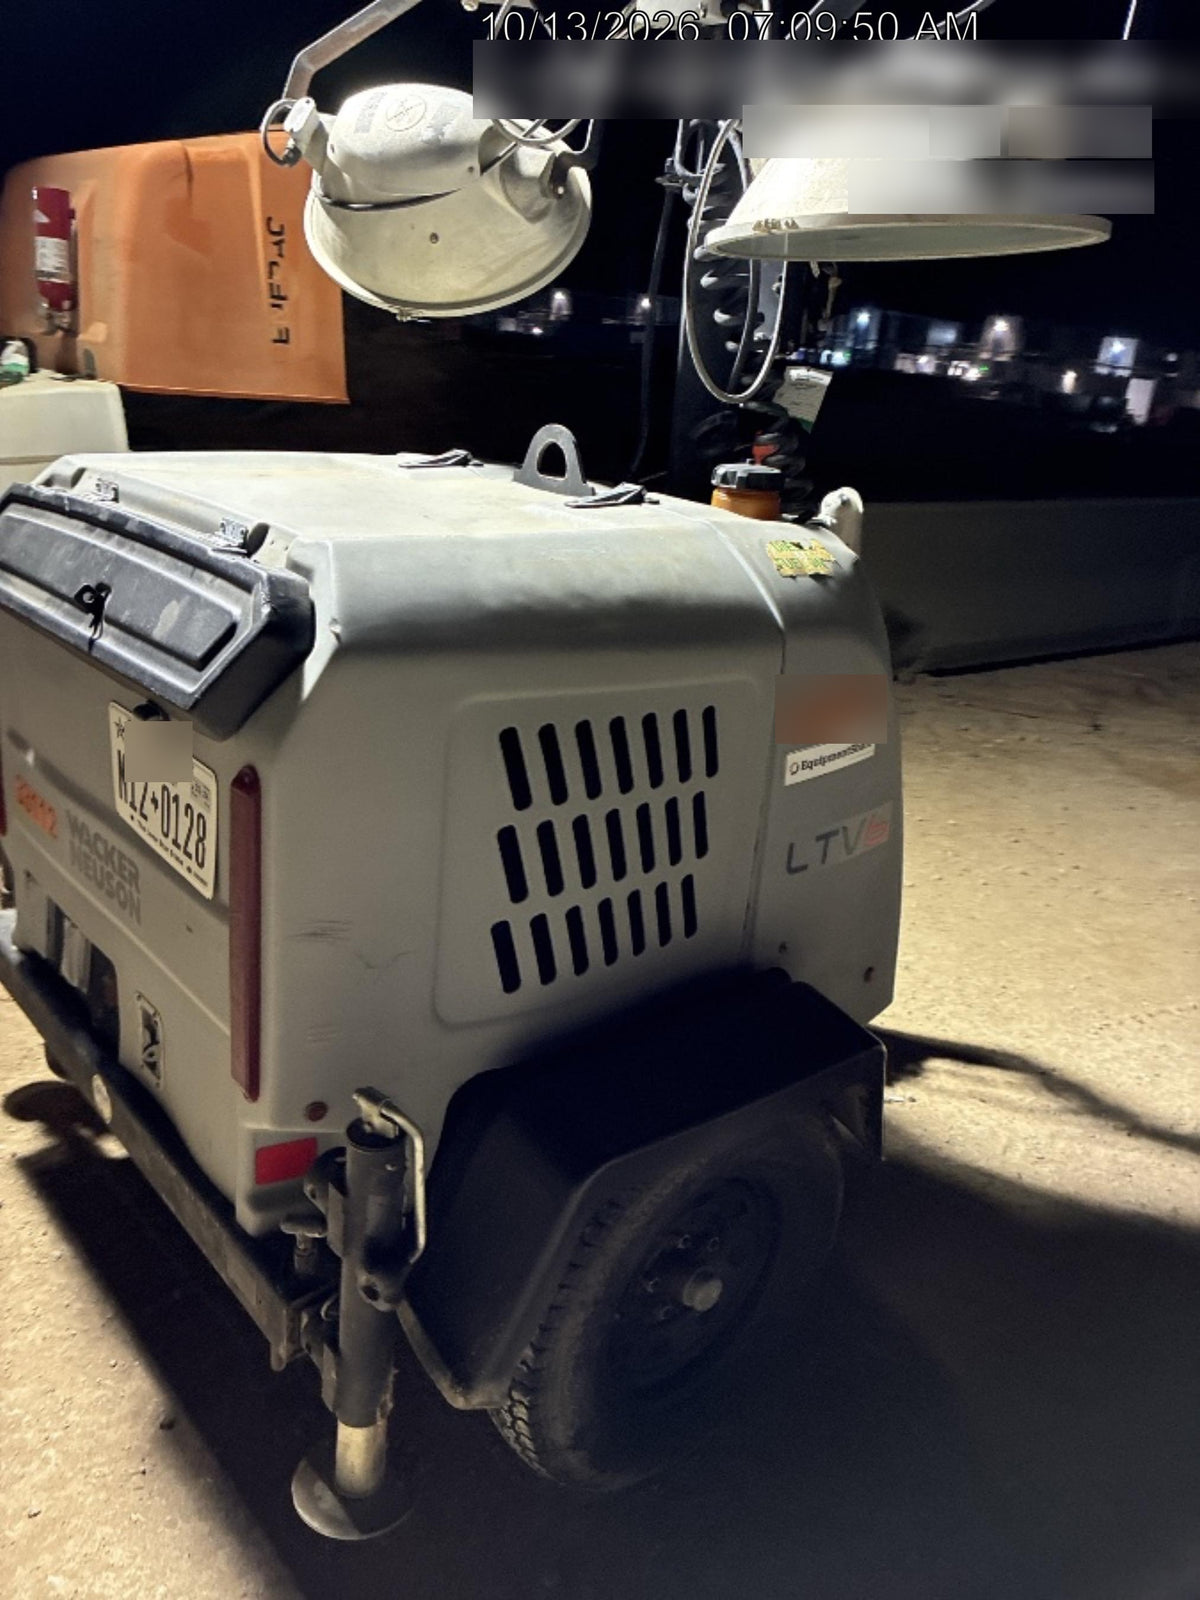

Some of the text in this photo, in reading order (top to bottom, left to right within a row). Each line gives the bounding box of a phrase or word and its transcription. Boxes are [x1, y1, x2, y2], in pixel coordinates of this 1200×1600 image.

[65, 808, 141, 896] WACKER
[161, 783, 207, 870] 0128
[68, 837, 142, 926] NEUSON
